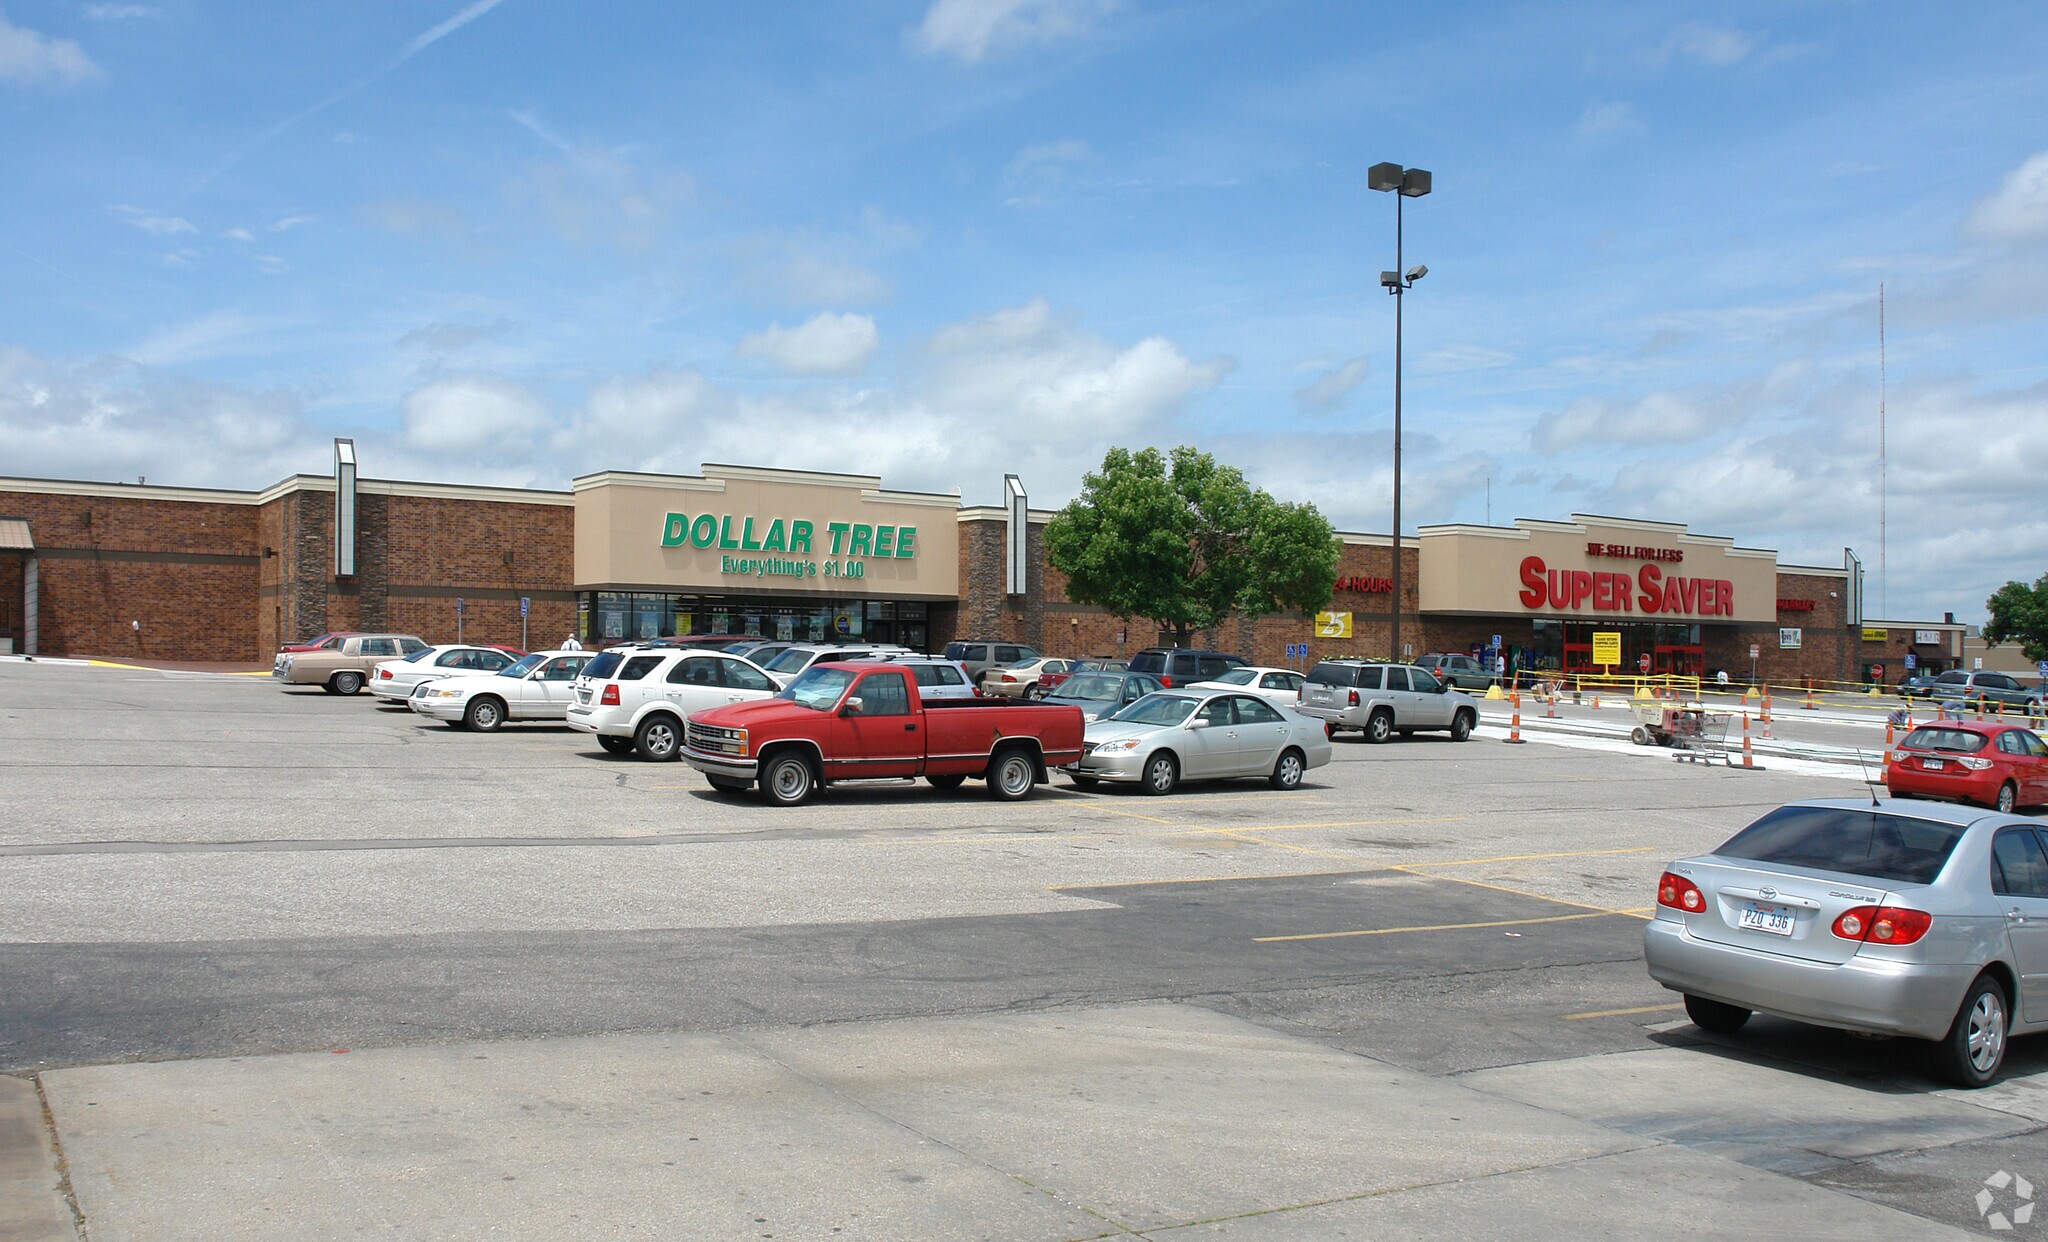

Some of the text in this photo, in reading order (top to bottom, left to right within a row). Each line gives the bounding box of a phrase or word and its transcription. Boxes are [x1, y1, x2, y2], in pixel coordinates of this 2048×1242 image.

[661, 512, 917, 558] DOLLAR TREE
[1588, 543, 1683, 562] WE SELL FOR LESS
[721, 555, 864, 578] Everything's $1.00
[1333, 576, 1393, 592] 24 HOURS
[1519, 556, 1734, 616] SUPER SAVER
[1320, 612, 1347, 637] 25
[1768, 913, 1788, 929] 336
